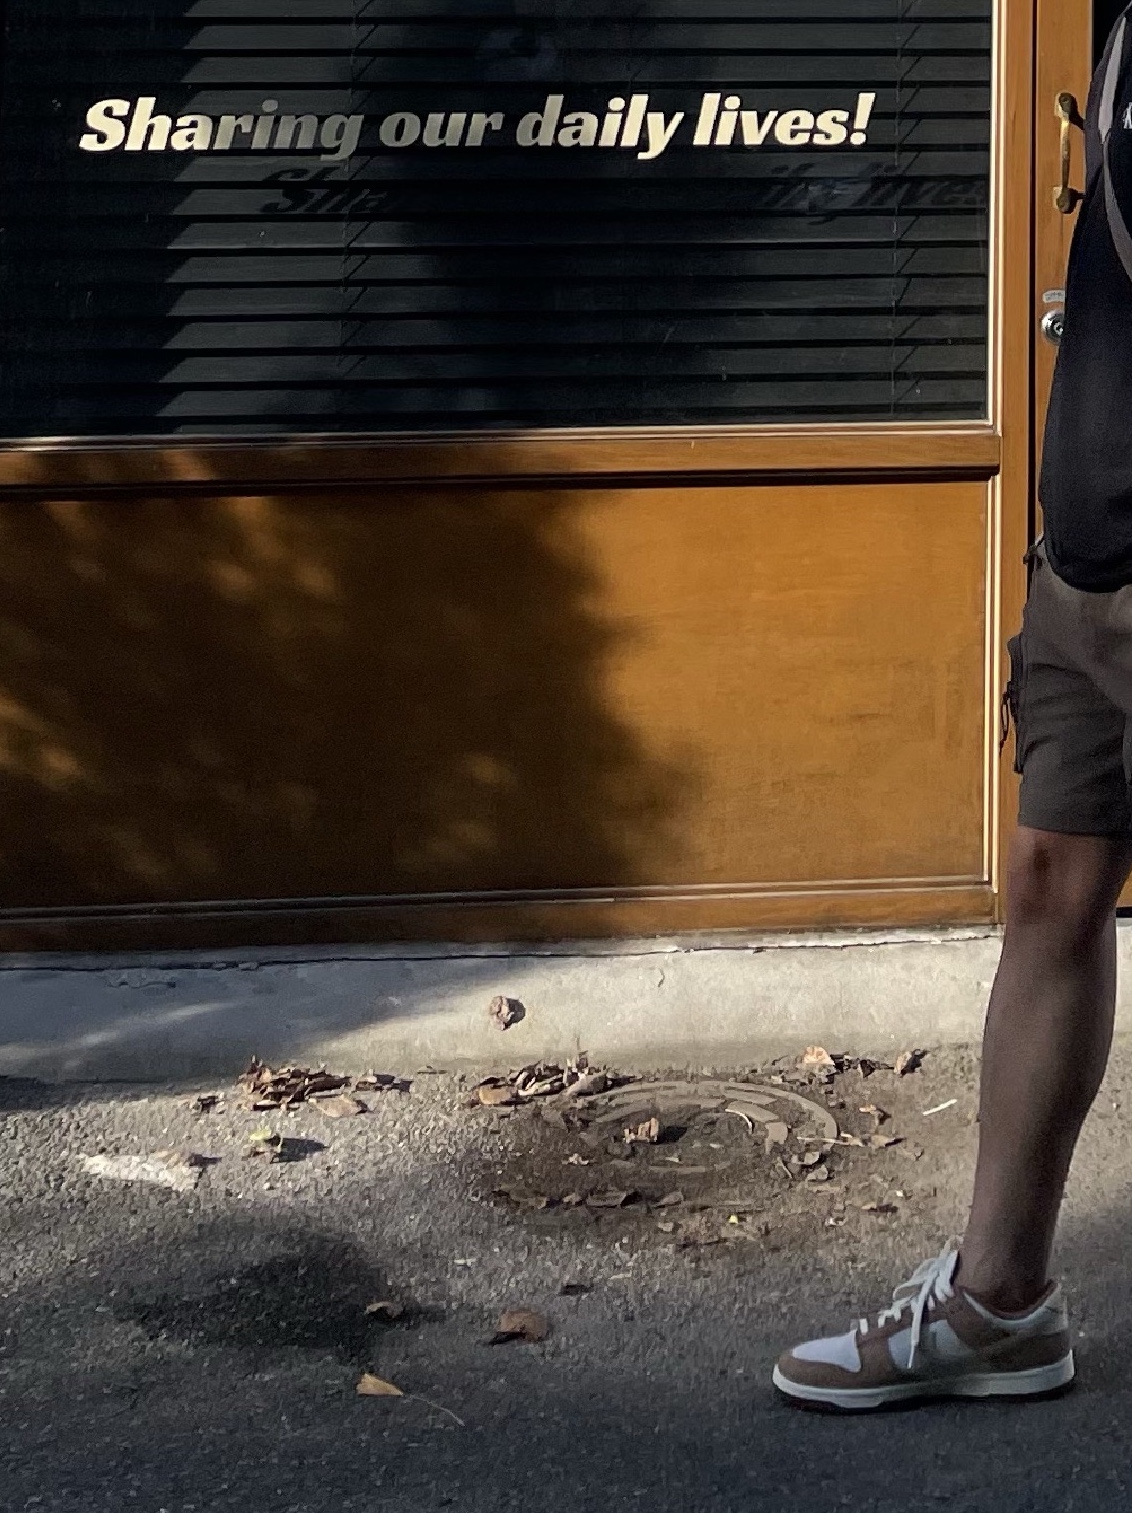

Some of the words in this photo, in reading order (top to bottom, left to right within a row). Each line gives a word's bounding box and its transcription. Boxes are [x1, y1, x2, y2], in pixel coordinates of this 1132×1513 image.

[79, 96, 364, 161] Sharing
[379, 111, 504, 147] our
[516, 93, 684, 160] daily
[693, 92, 876, 146] lives!
